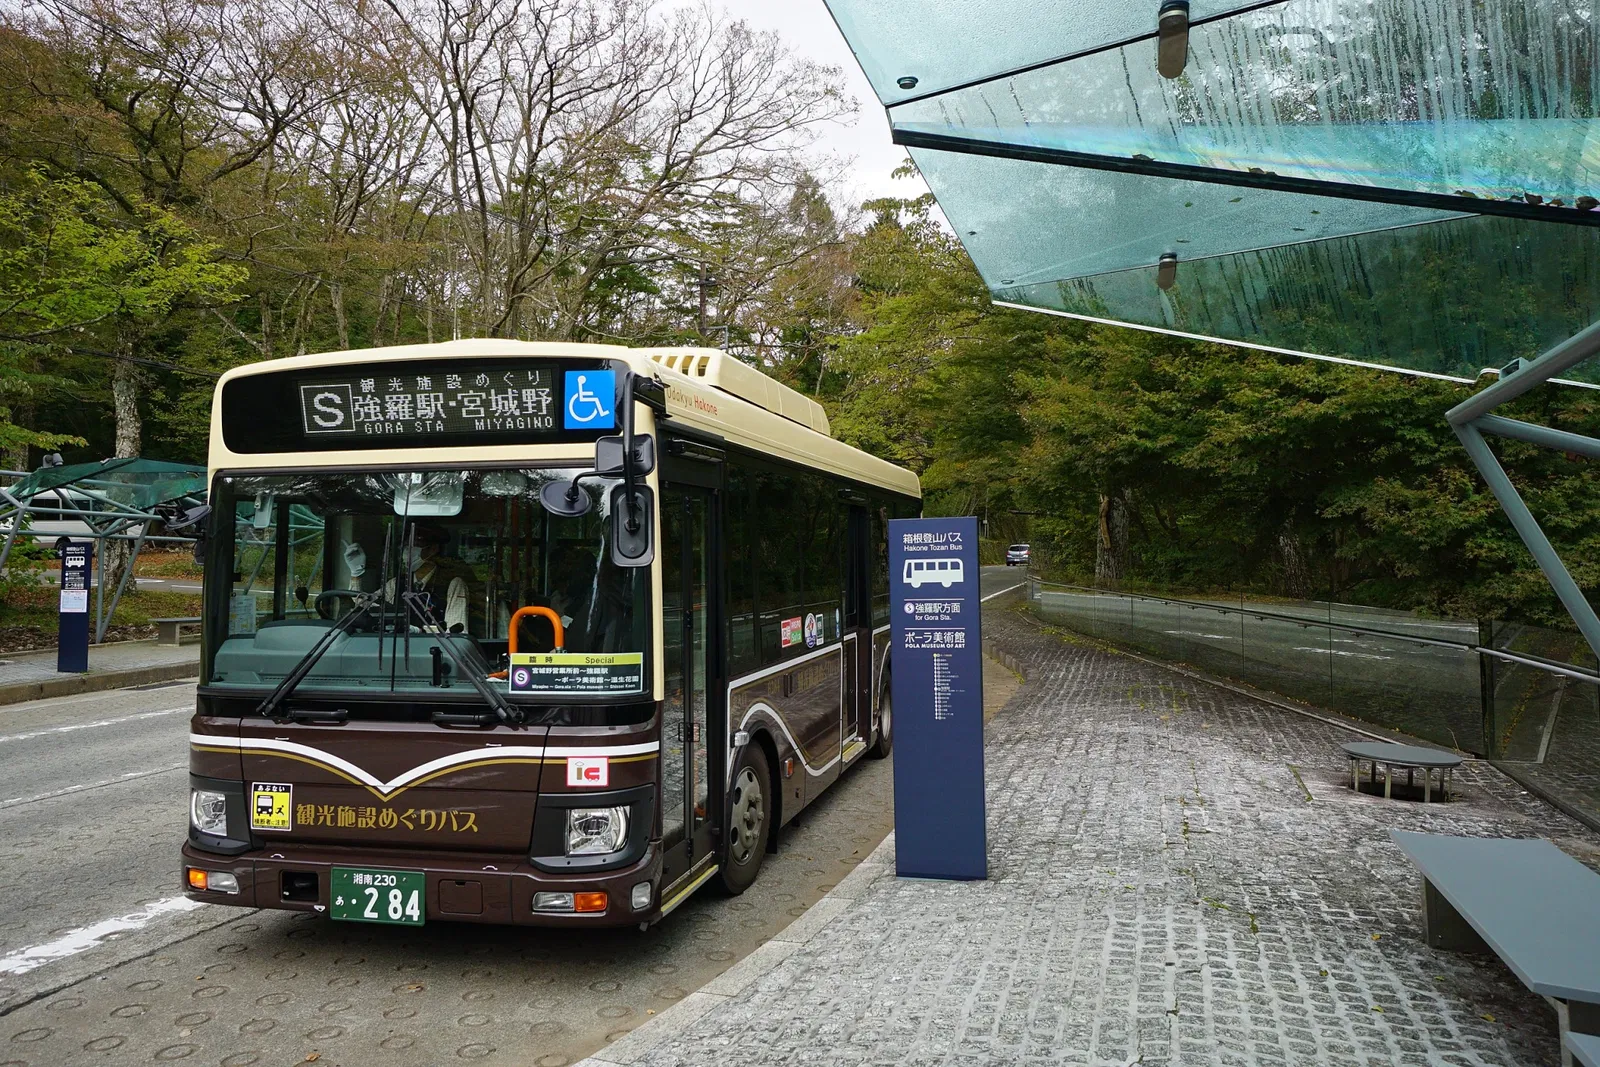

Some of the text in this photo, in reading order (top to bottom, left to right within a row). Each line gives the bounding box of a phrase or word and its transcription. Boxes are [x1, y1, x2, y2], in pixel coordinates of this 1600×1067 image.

[360, 370, 541, 393] 観光施設めぐり
[313, 391, 345, 428] S
[694, 393, 718, 416] Hakone
[364, 417, 553, 434] GORA STA MIYAGINO
[903, 532, 963, 544] 箱根登山バス
[949, 543, 963, 551] Bus
[915, 602, 961, 614] 強羅駅方面
[905, 631, 965, 644] ポーラ美術館
[585, 656, 615, 664] Special
[516, 672, 525, 682] S
[257, 784, 286, 793] あぶない
[296, 804, 479, 833] 観光施設めぐりバス
[335, 895, 345, 907] あ
